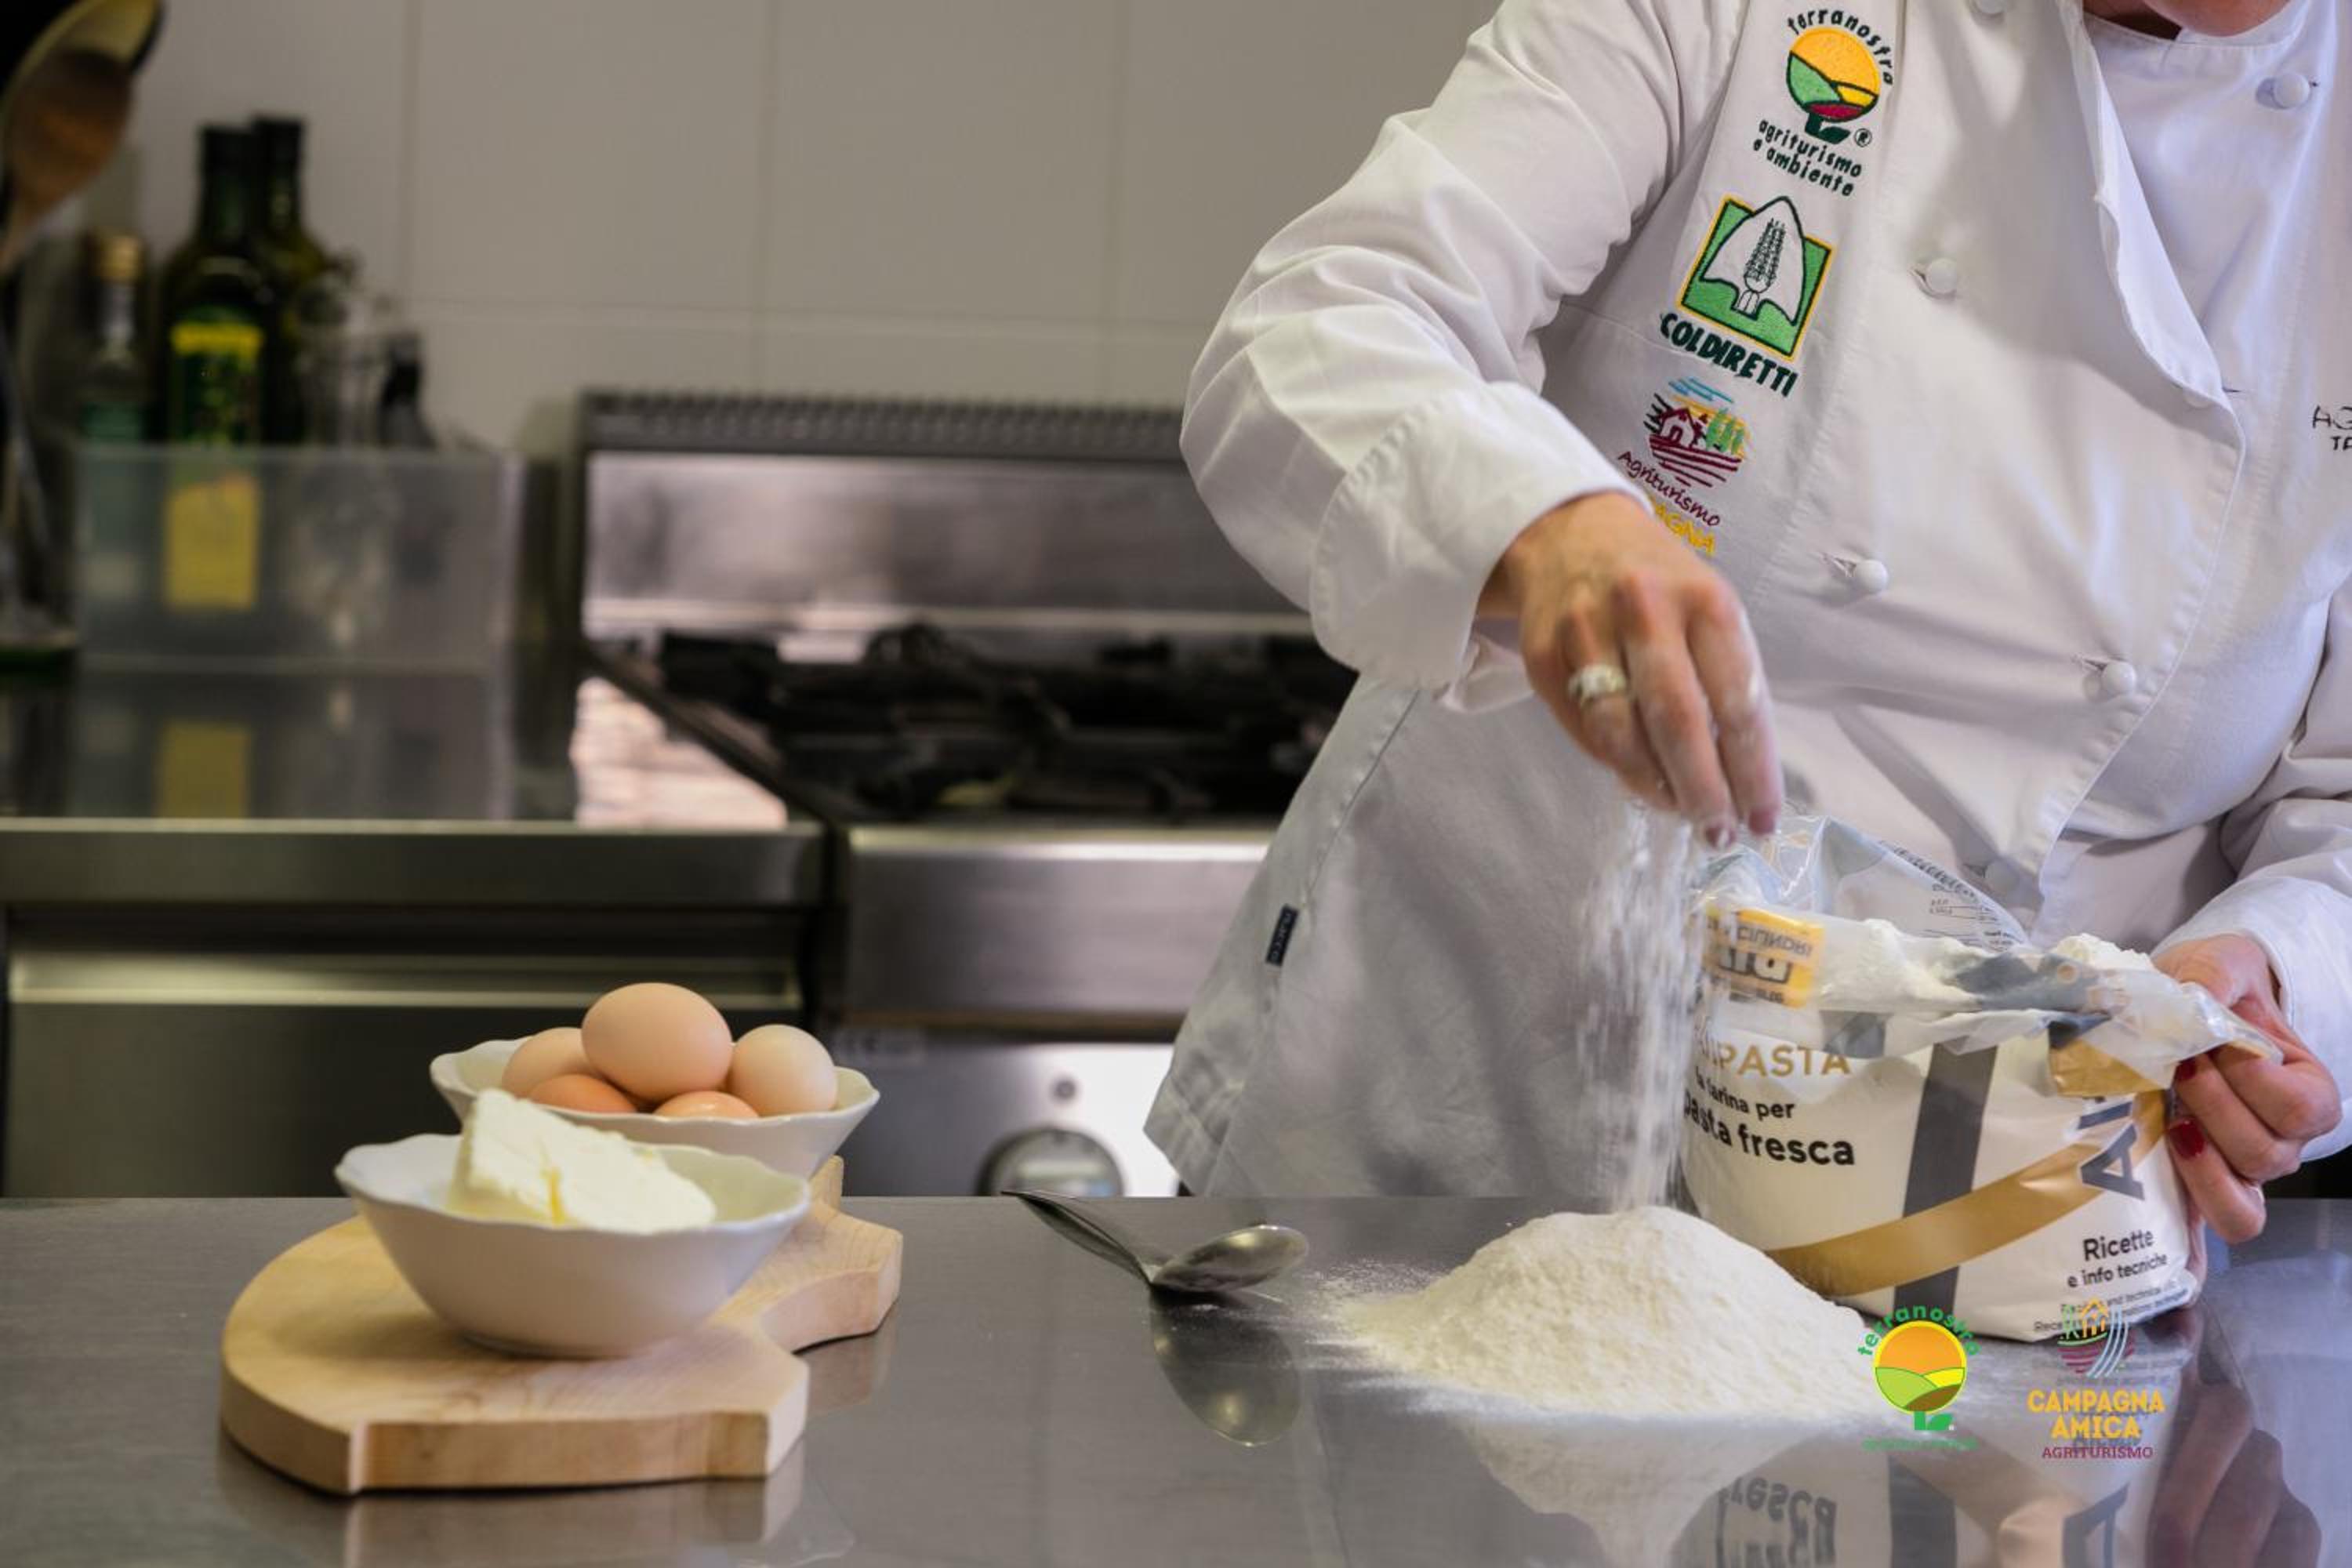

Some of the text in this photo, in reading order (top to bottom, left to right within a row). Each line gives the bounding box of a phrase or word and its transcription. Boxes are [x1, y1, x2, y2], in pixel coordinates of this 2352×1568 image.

[1788, 9, 1893, 85] terranostra
[1752, 138, 1854, 198] e ambiente
[1759, 118, 1862, 178] agriturismo
[1660, 313, 1798, 397] COLDIRETTI
[1617, 450, 1721, 527] Agriturismo
[1755, 1102, 1795, 1121] per
[1737, 1123, 1855, 1166] fresca
[2067, 1253, 2168, 1288] e info tecniche
[2083, 1229, 2154, 1261] Ricette
